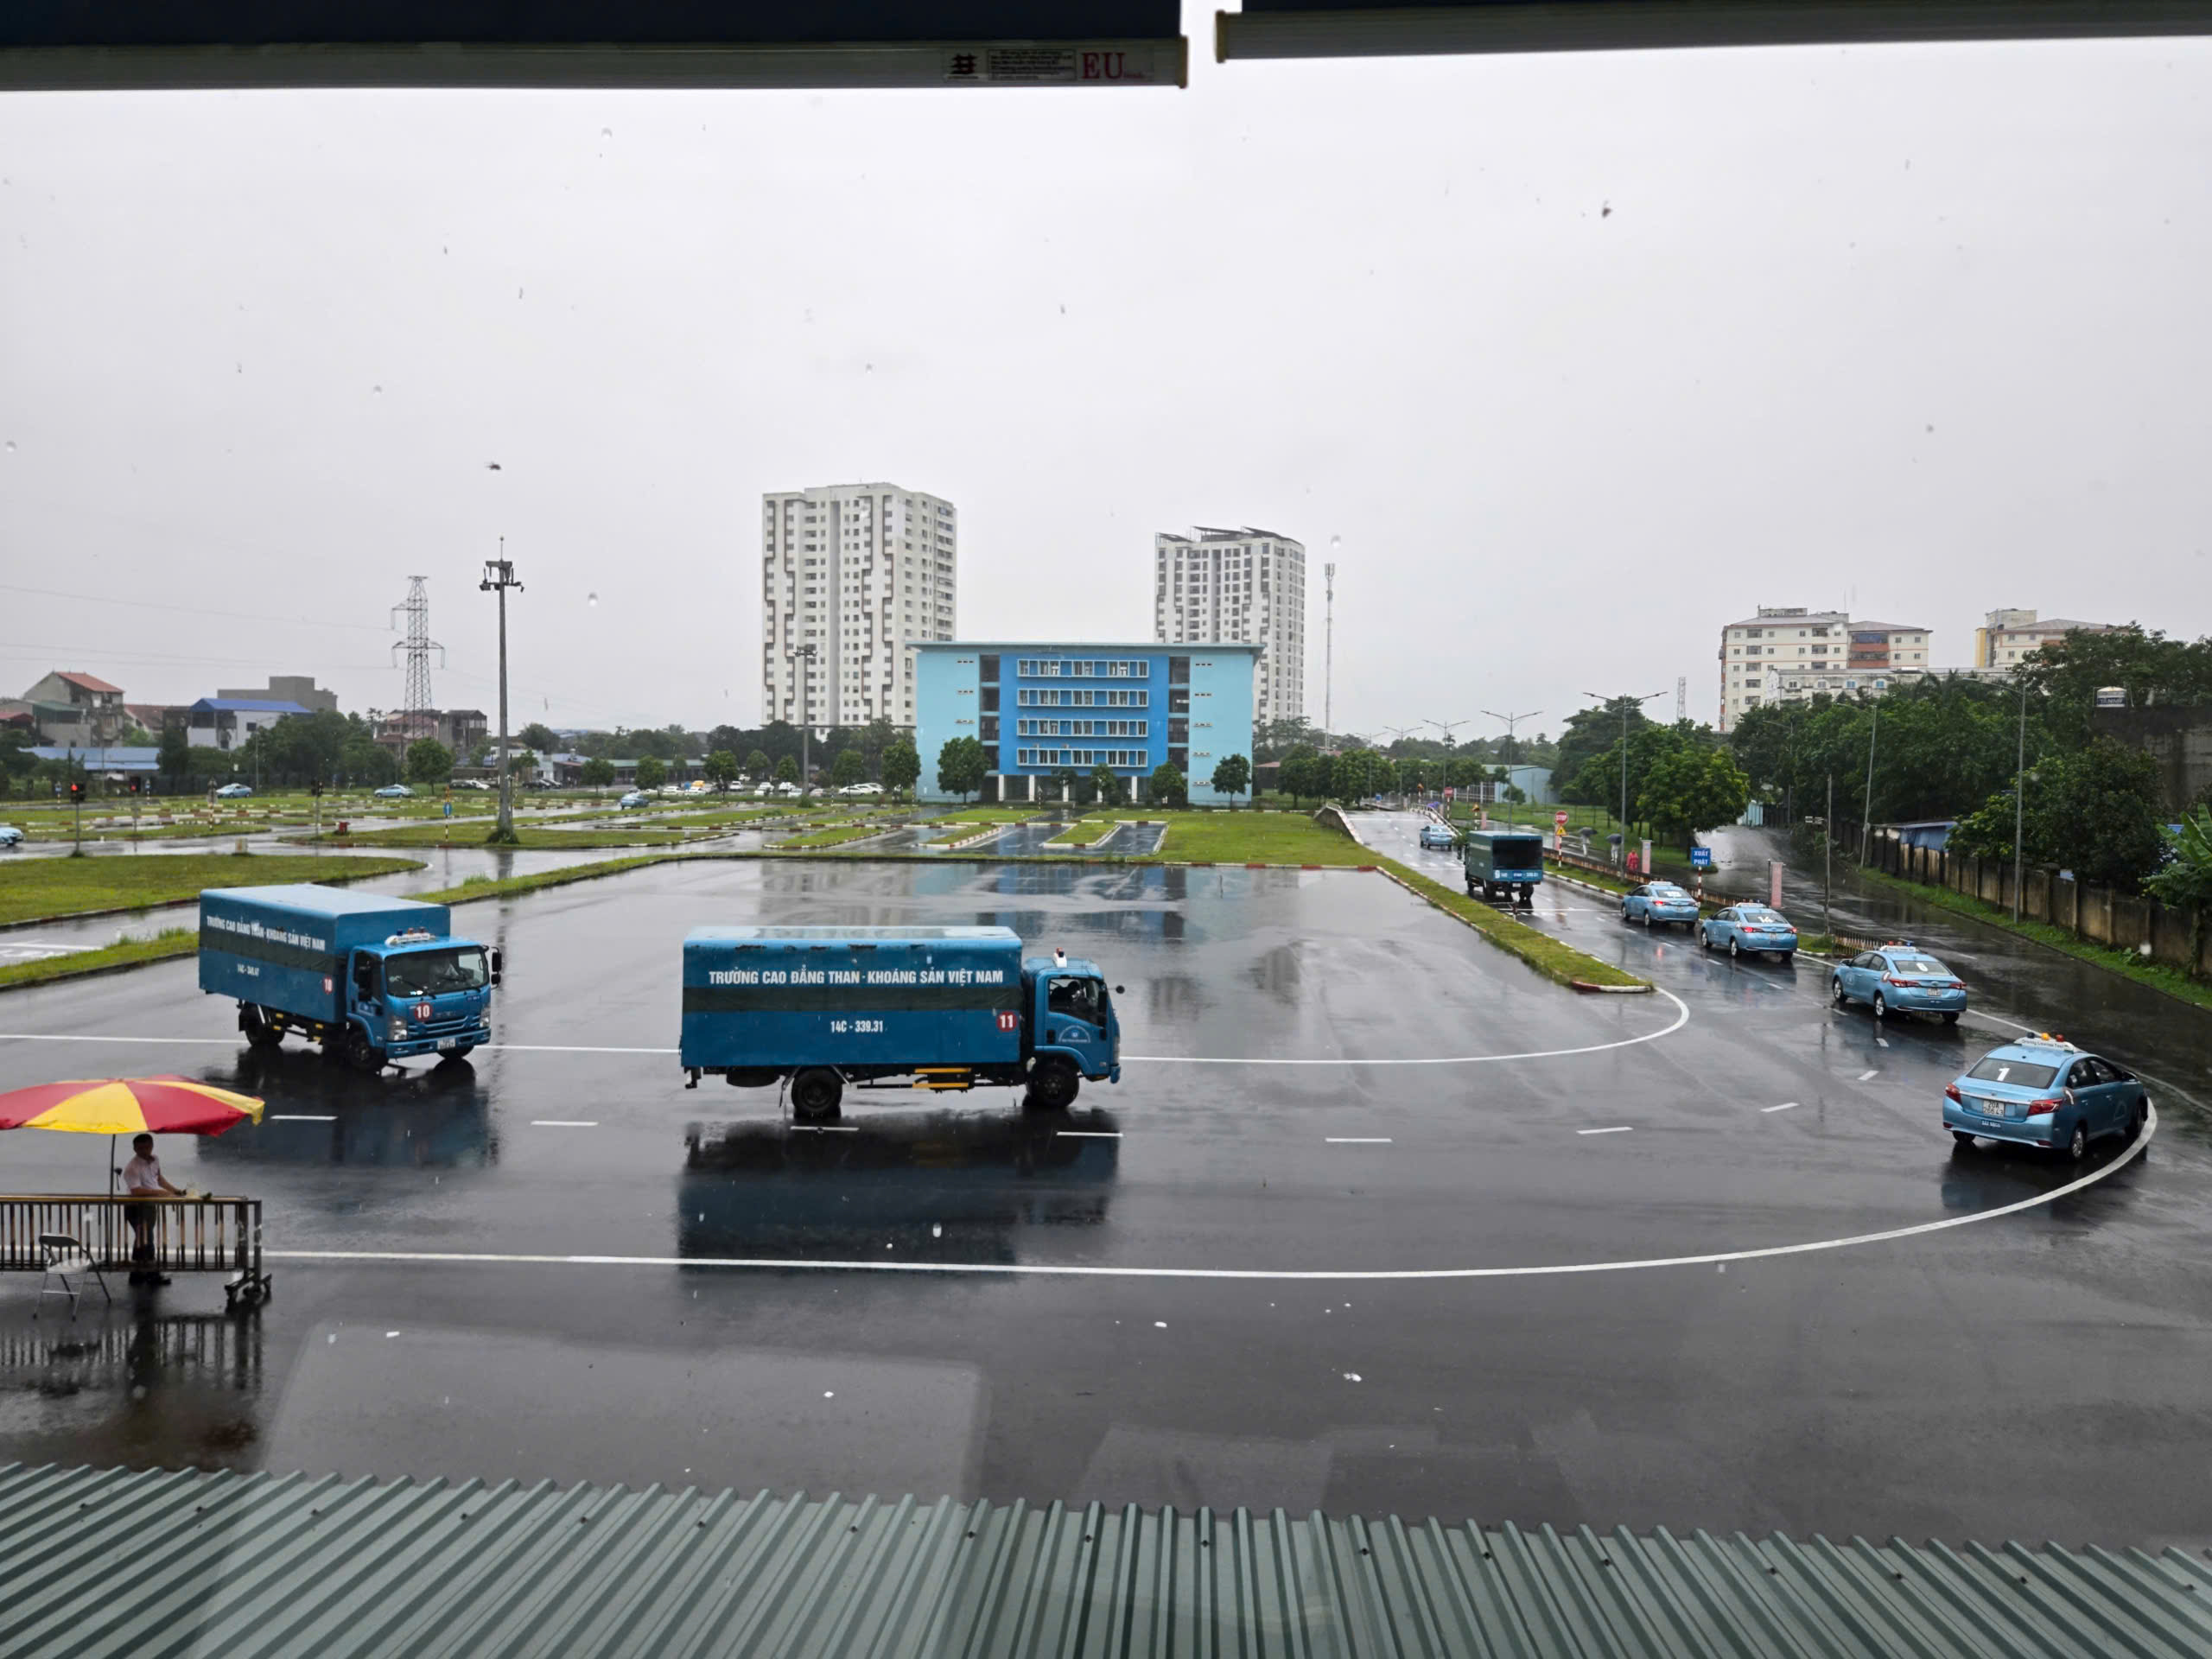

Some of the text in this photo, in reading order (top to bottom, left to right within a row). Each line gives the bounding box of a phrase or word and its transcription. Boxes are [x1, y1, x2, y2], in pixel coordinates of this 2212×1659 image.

[1081, 52, 1127, 79] EU
[226, 919, 236, 932] CAO
[312, 938, 325, 951] NAM
[709, 966, 759, 984] TRƯỜNG
[762, 970, 786, 984] CAO
[791, 963, 825, 984] ĐẲNG
[828, 970, 861, 983] THAN
[868, 968, 916, 983] KHOÁNG
[919, 966, 944, 983] SẢN
[948, 968, 973, 987] VIỆT
[976, 969, 1003, 983] NAM
[324, 978, 333, 992] 10
[416, 1005, 430, 1019] 10
[830, 1020, 848, 1033] 14C
[855, 1020, 883, 1033] 339.31
[1000, 1014, 1014, 1028] 11
[1997, 1067, 2010, 1081] 1
